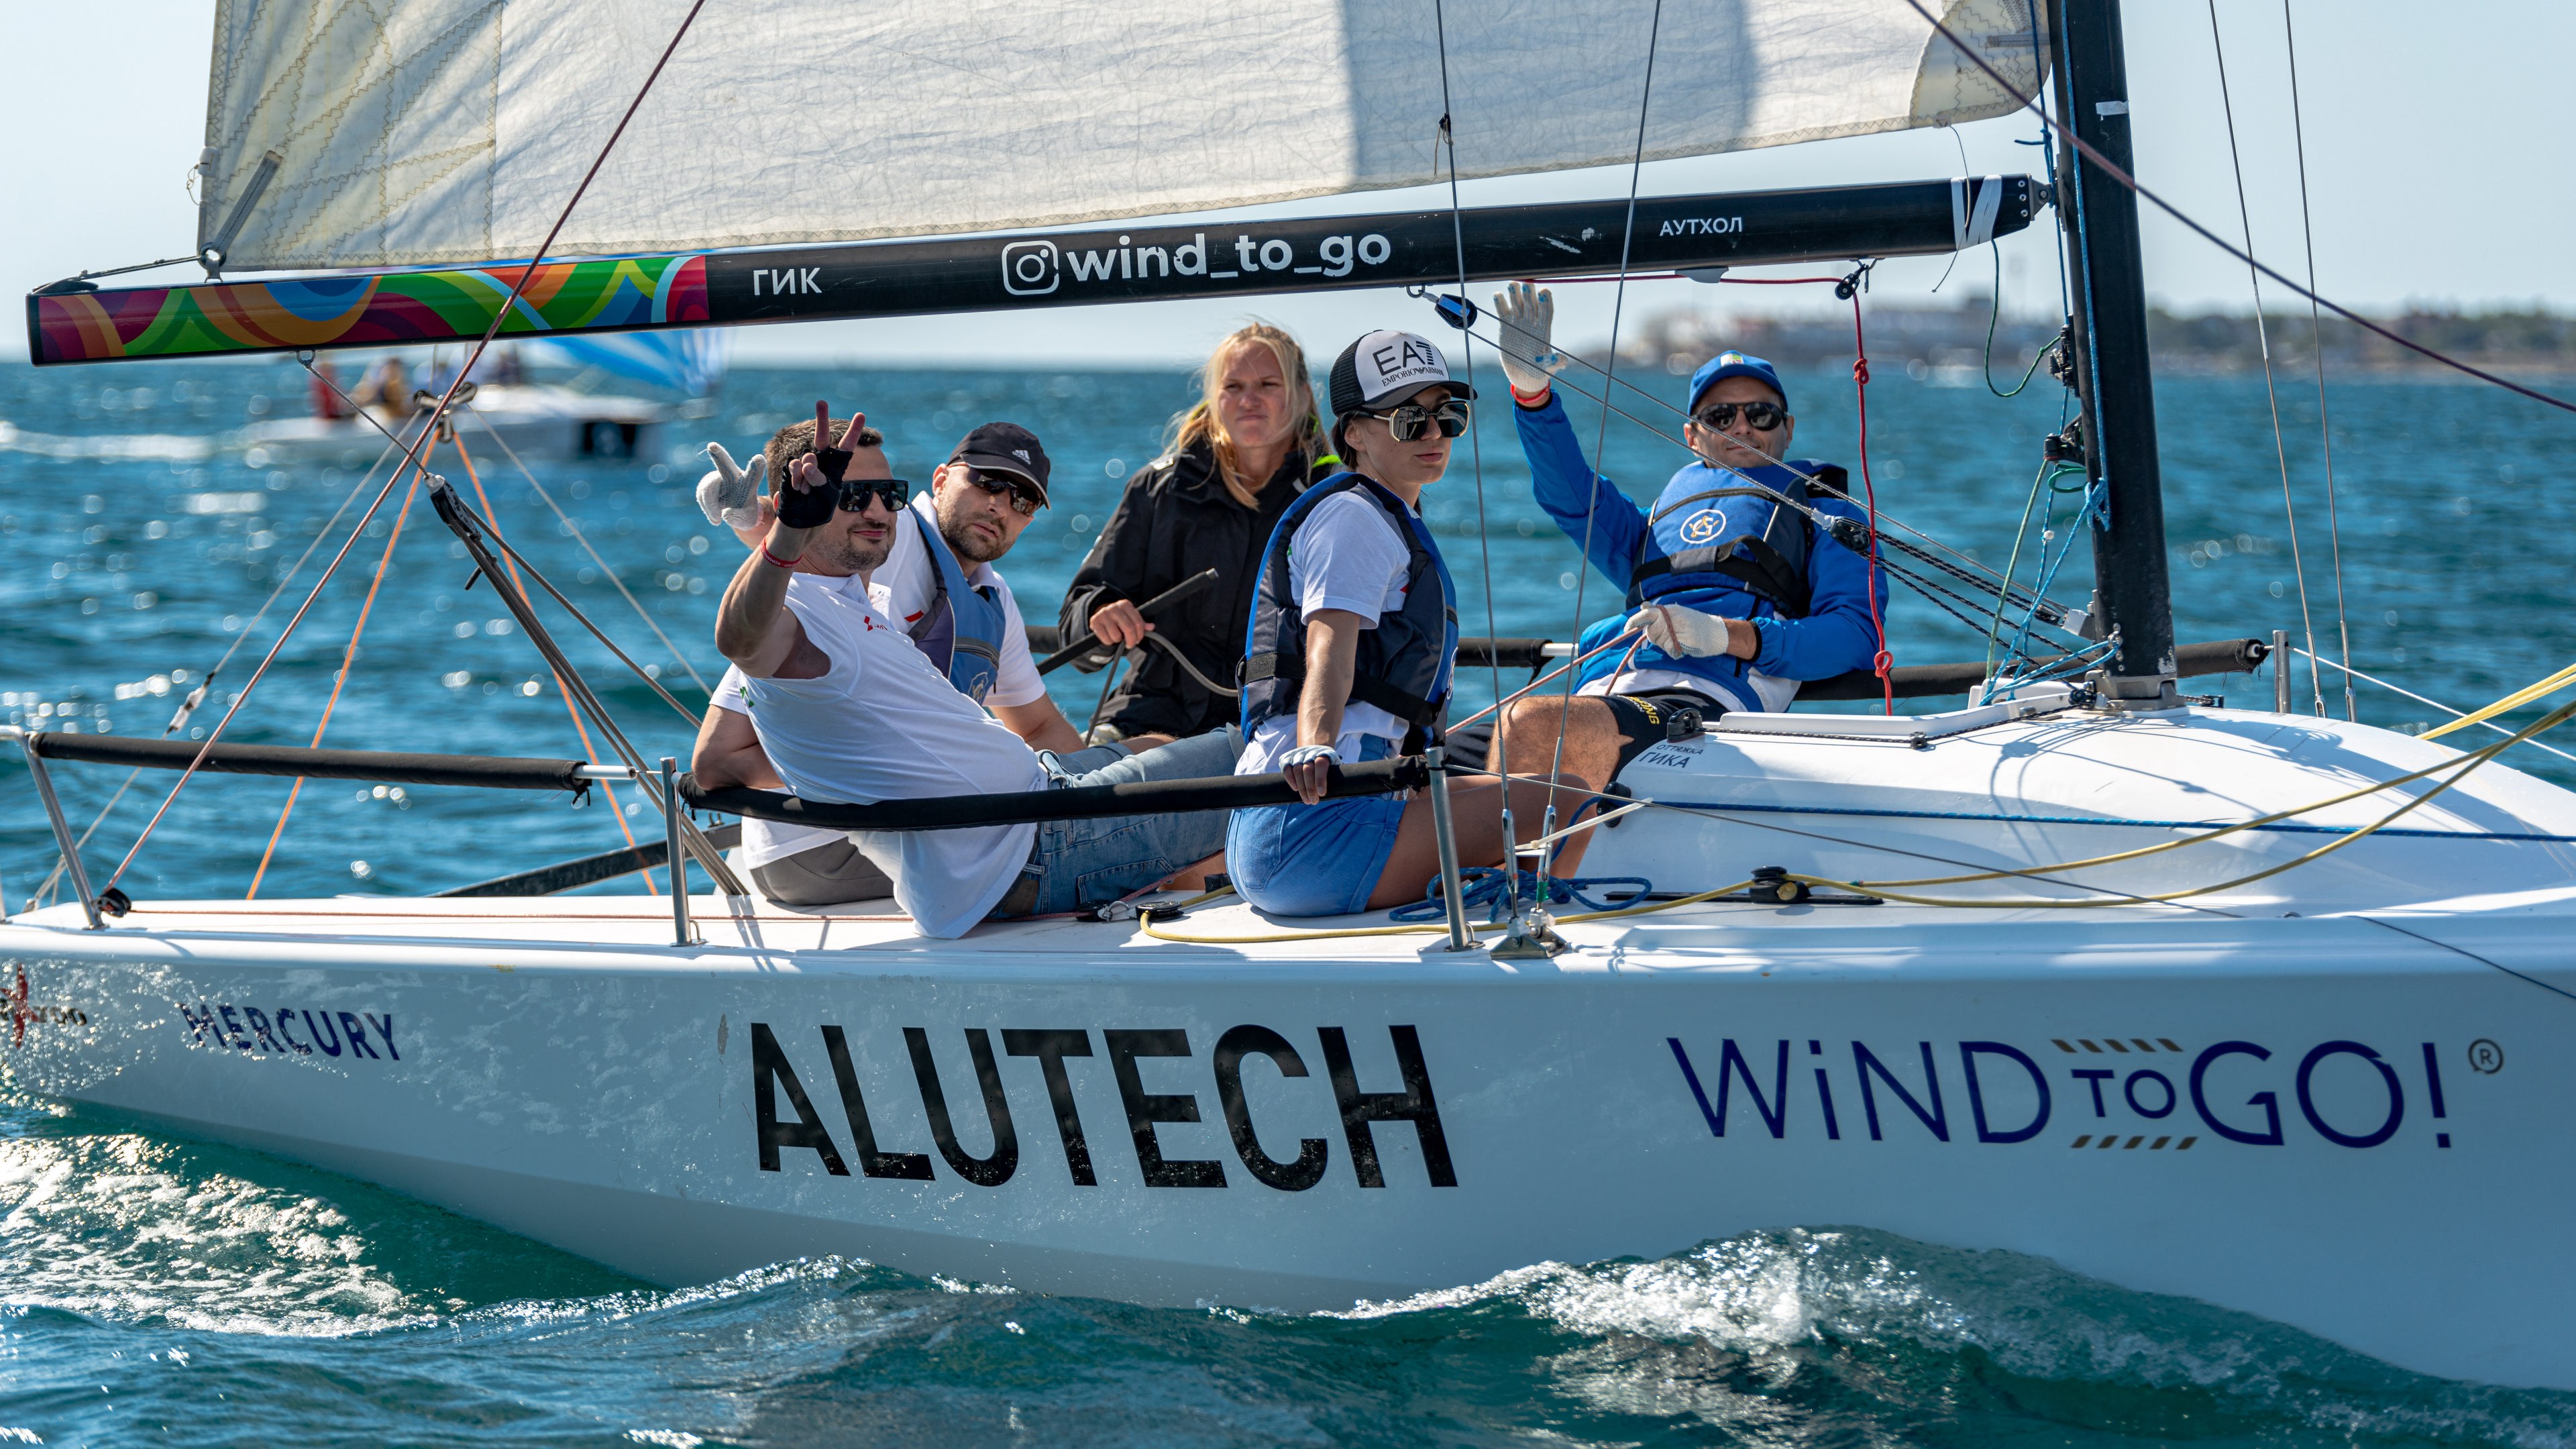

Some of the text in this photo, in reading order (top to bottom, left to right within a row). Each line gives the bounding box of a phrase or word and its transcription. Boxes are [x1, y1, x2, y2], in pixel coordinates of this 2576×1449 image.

[1659, 217, 1743, 237] АУТХОЛ
[1065, 232, 1392, 282] wind_to_go
[753, 267, 823, 297] ГИК
[1372, 340, 1435, 376] EA7
[1381, 367, 1417, 387] EMPORIO
[1638, 751, 1691, 769] ГИКА
[1656, 744, 1705, 755] ОТТЯЖКА
[180, 1003, 401, 1061] MERCURY
[750, 1022, 1459, 1193] ALUTECH
[2189, 1039, 2452, 1150] GO!
